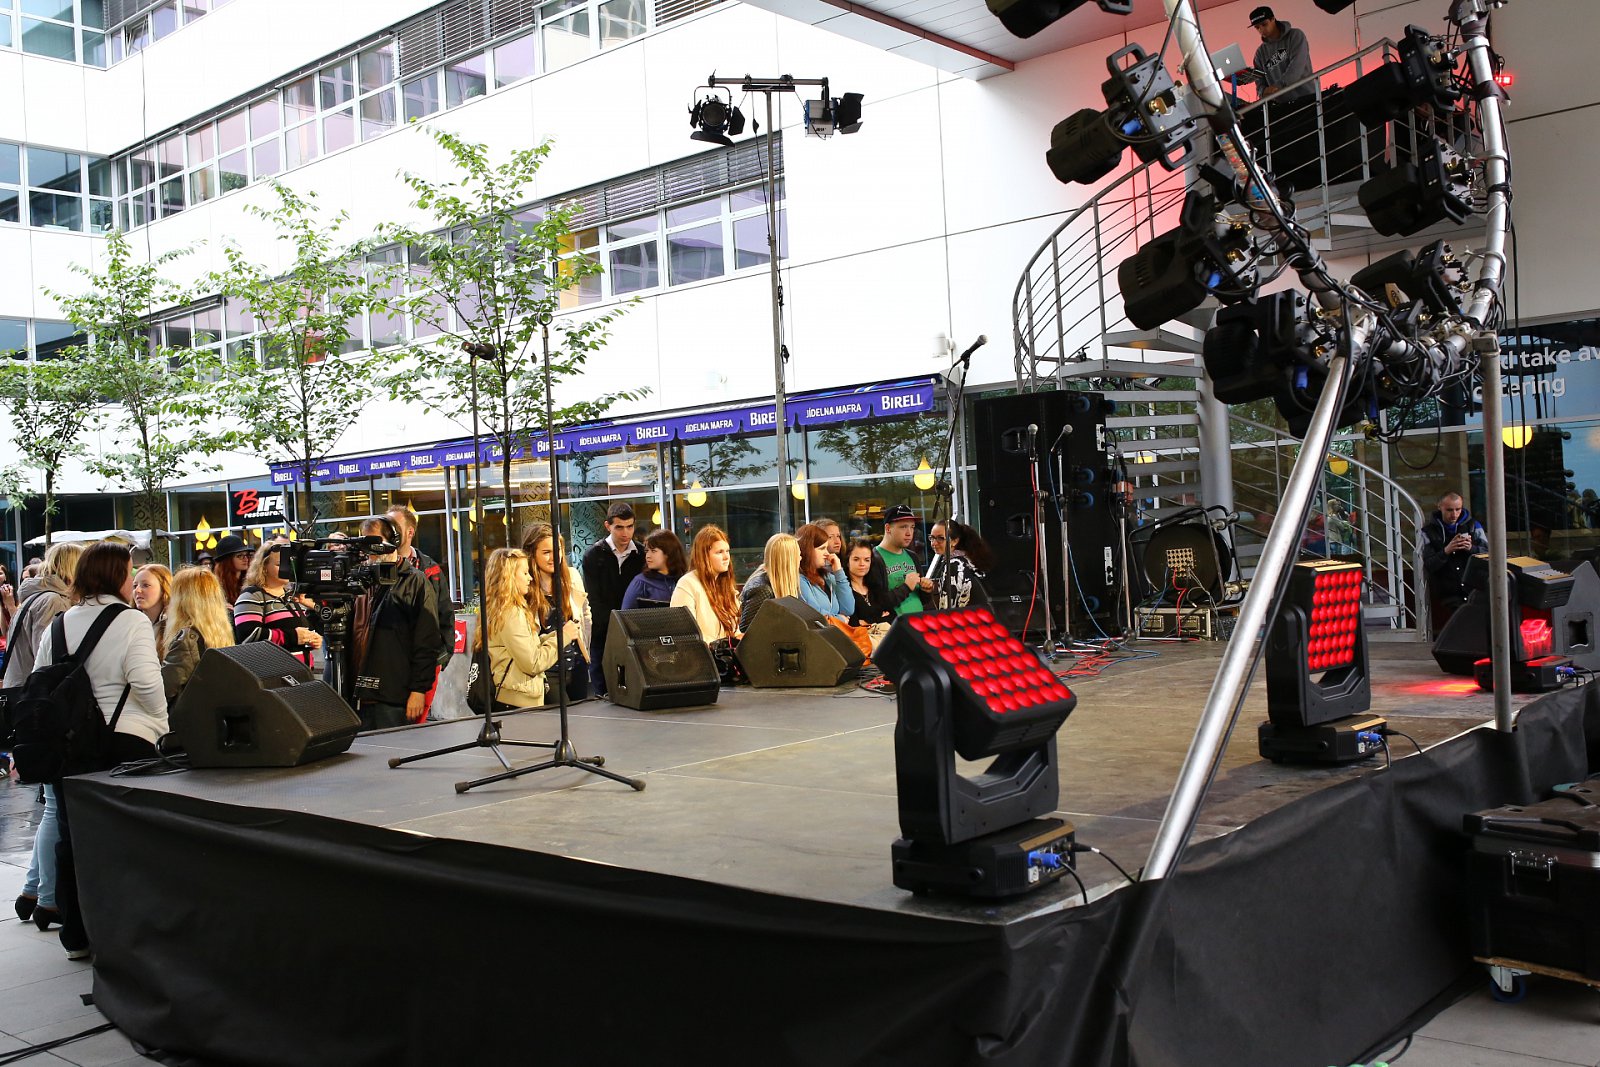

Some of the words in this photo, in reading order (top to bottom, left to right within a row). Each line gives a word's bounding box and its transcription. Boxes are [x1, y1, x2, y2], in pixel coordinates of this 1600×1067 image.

[1520, 346, 1571, 368] take
[1472, 377, 1566, 400] ctering
[882, 393, 924, 410] BIRELL
[835, 403, 862, 414] MAFRA
[710, 419, 733, 430] MAFRA
[601, 433, 621, 444] MAFRA
[636, 426, 668, 440] BIRELL
[410, 454, 434, 466] BIRELL
[464, 451, 479, 460] MAFR
[338, 463, 360, 475] BIRELL
[274, 471, 293, 482] BIRELL
